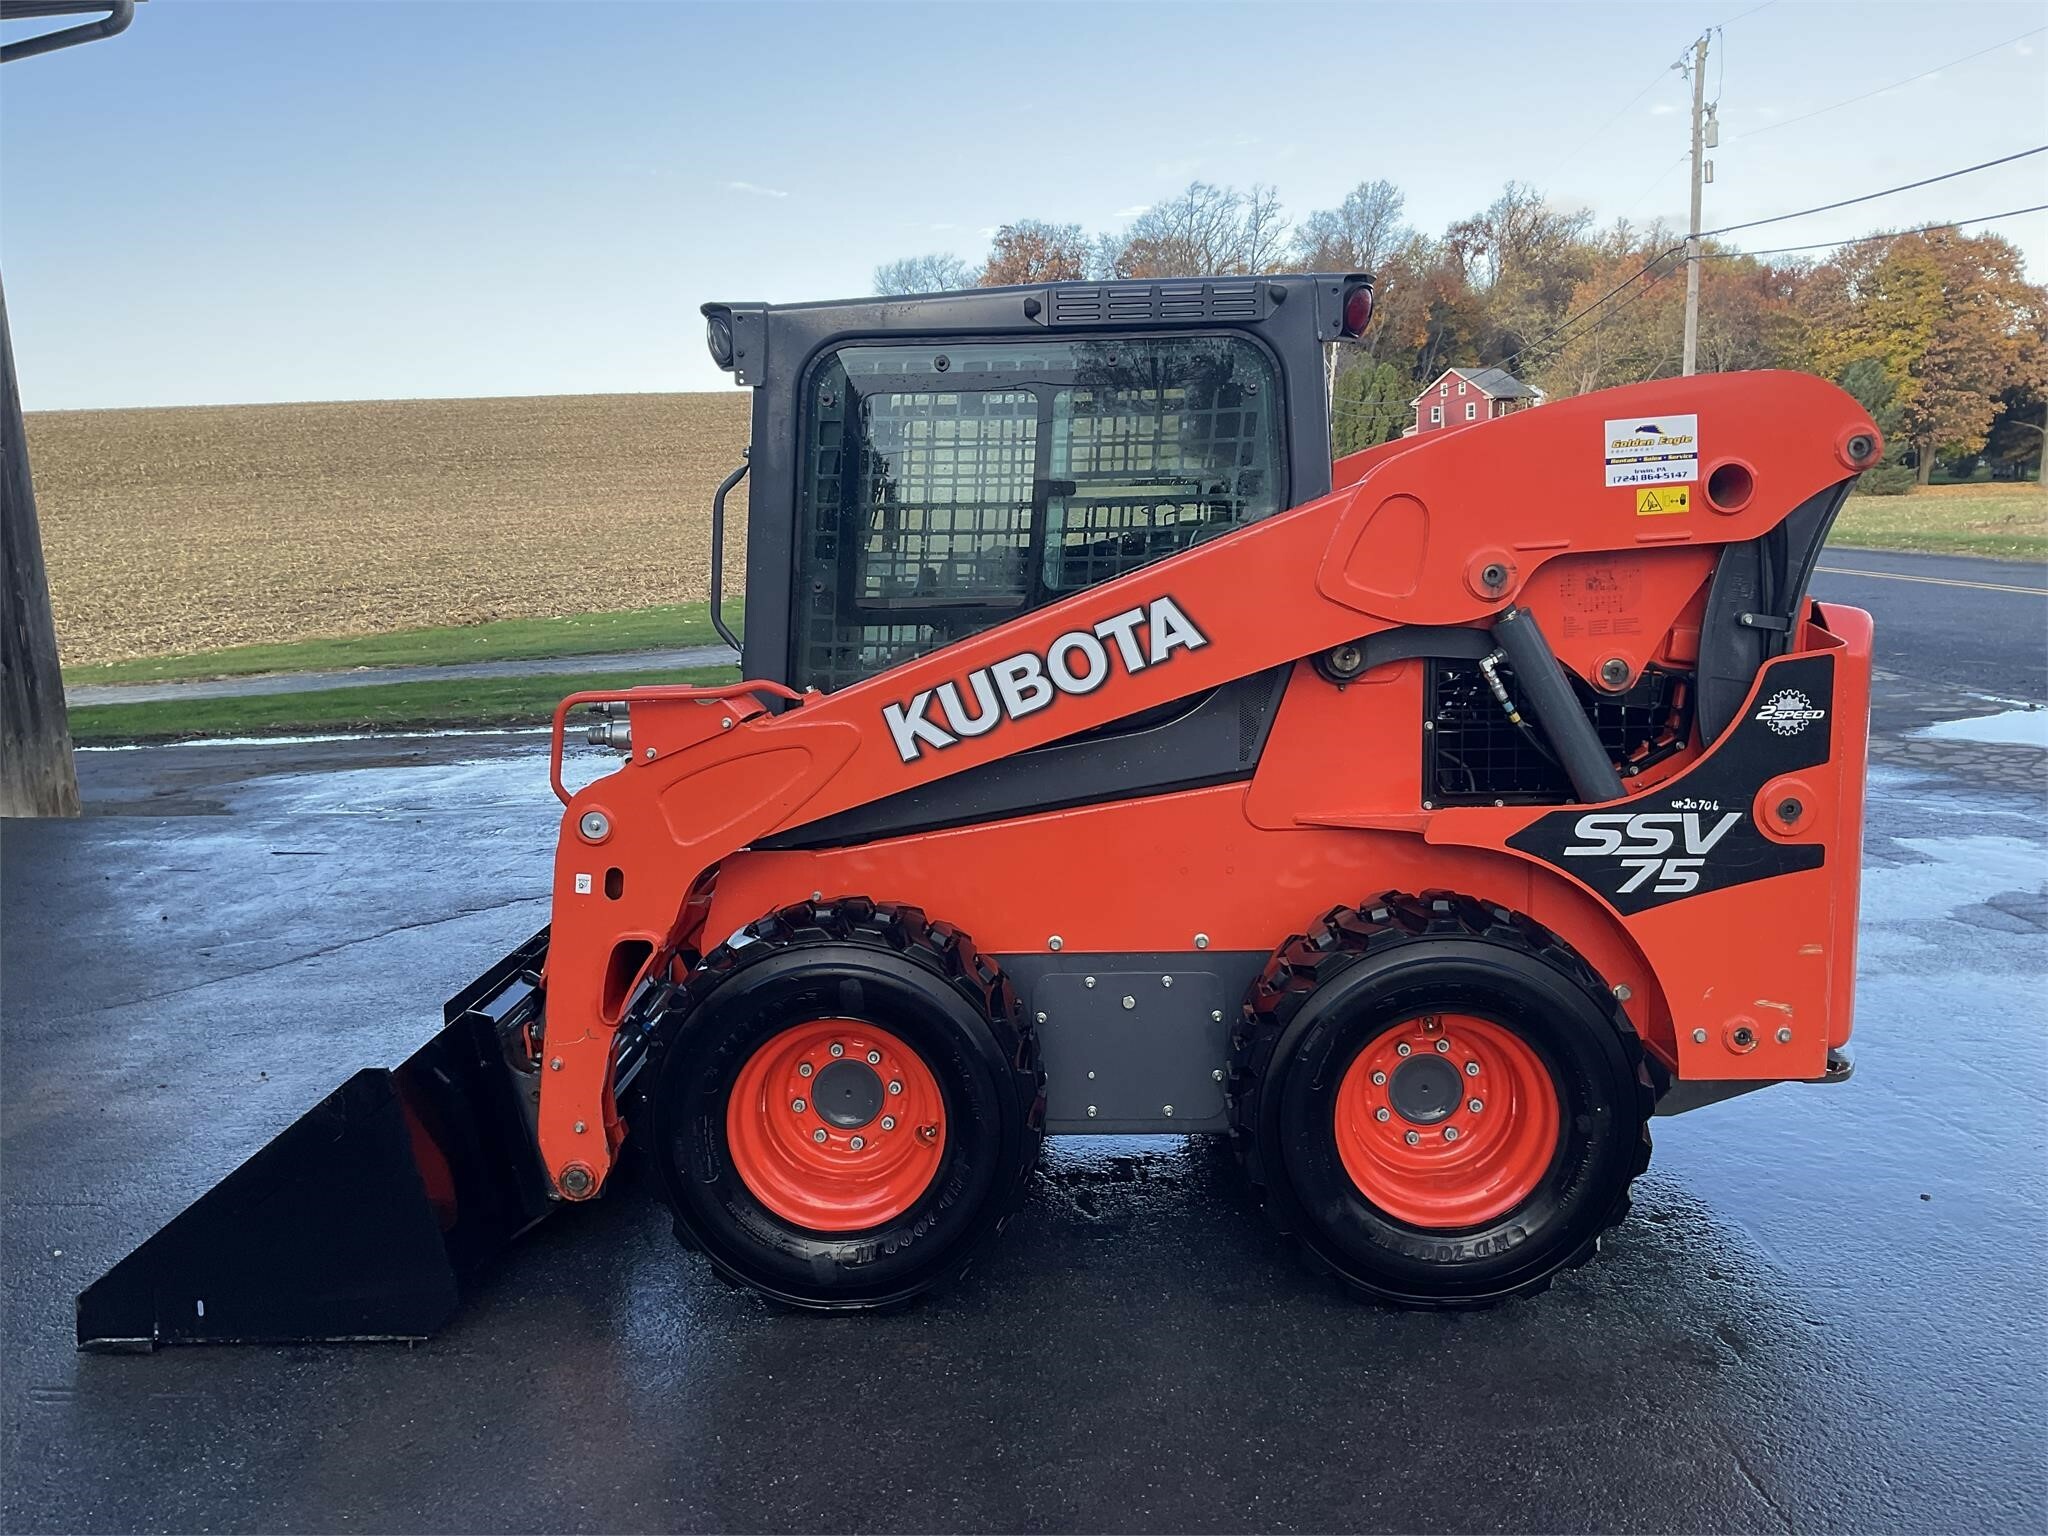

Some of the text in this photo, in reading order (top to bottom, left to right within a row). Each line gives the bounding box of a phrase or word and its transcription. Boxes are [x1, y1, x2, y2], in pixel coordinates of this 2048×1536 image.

[1612, 434, 1693, 448] Golden Eagle
[1667, 452, 1694, 460] Service
[1613, 471, 1688, 484] (724) 864-5147
[882, 596, 1208, 763] KUBOTA
[1563, 812, 1743, 856] SSV
[1616, 858, 1706, 893] 75
